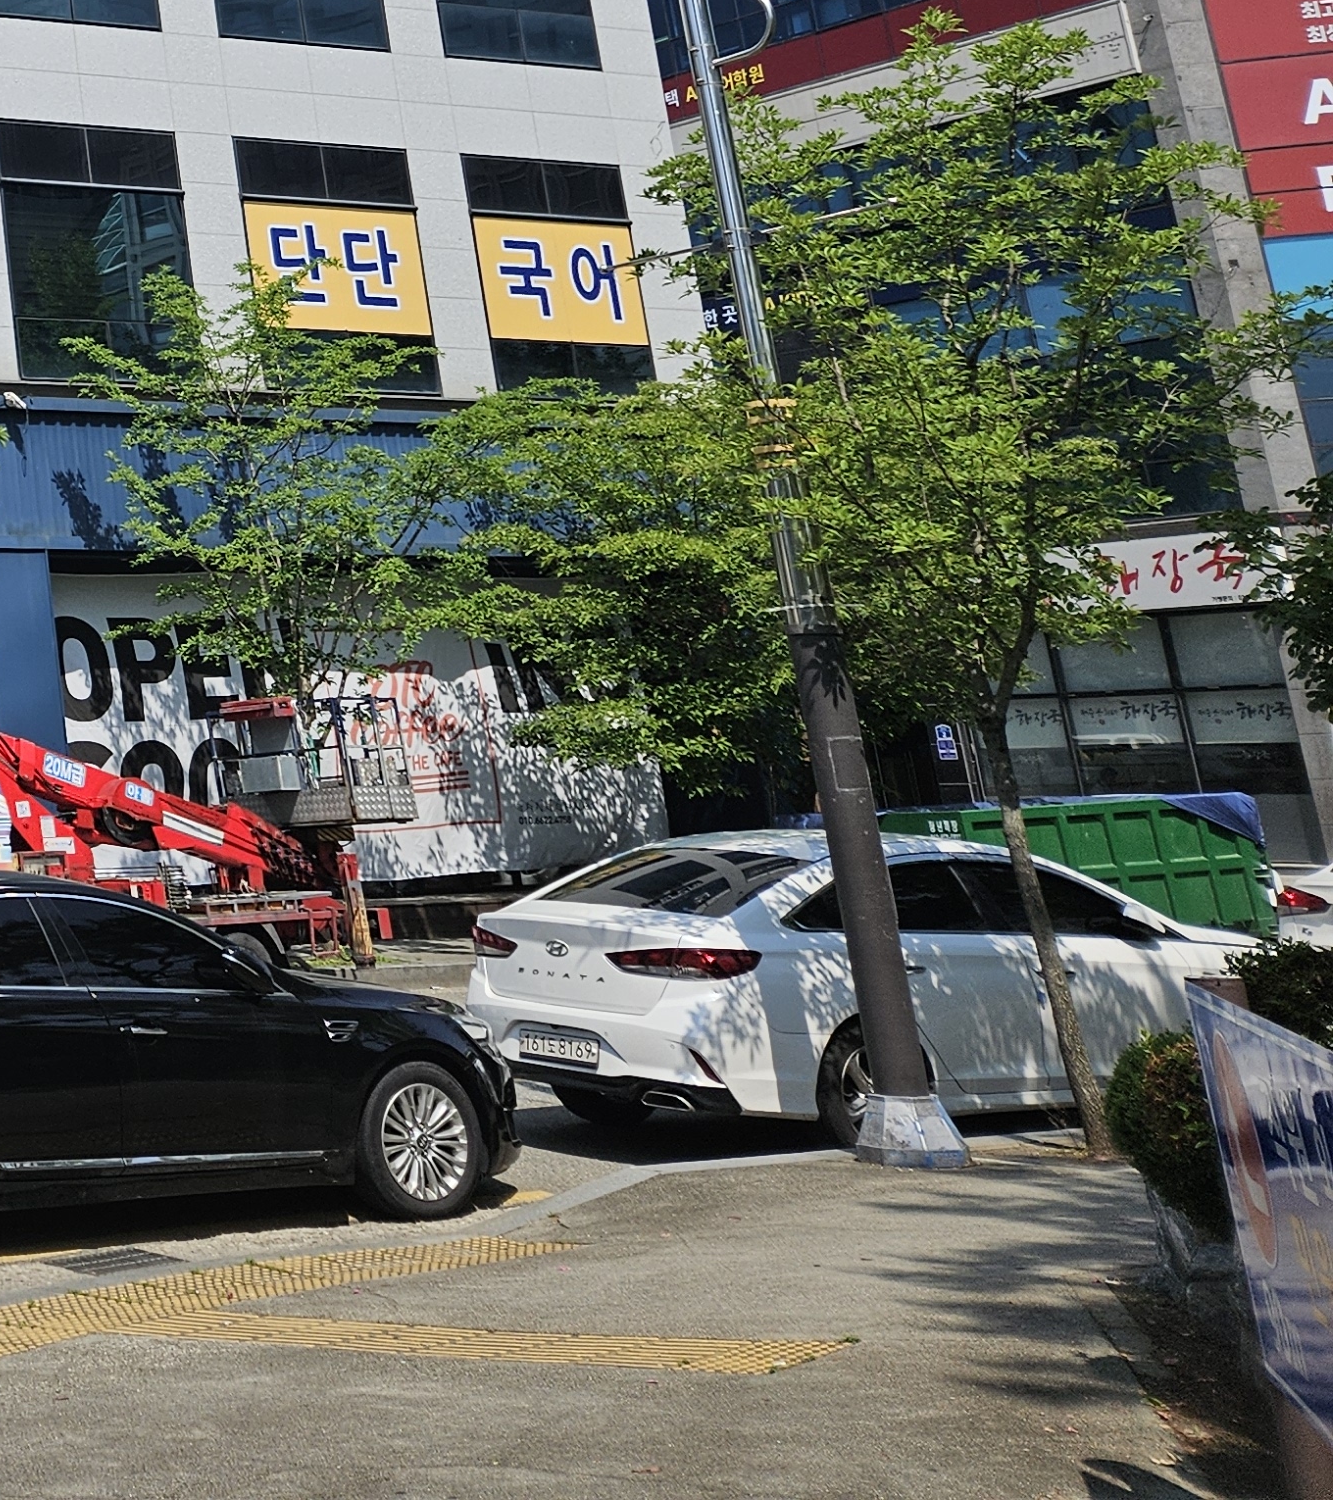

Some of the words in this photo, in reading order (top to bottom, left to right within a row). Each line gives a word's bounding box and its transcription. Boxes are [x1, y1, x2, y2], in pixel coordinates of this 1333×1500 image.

[267, 222, 399, 308] 단단
[498, 238, 625, 322] 국어
[45, 754, 84, 787] 20M급
[518, 967, 605, 983] SONATA
